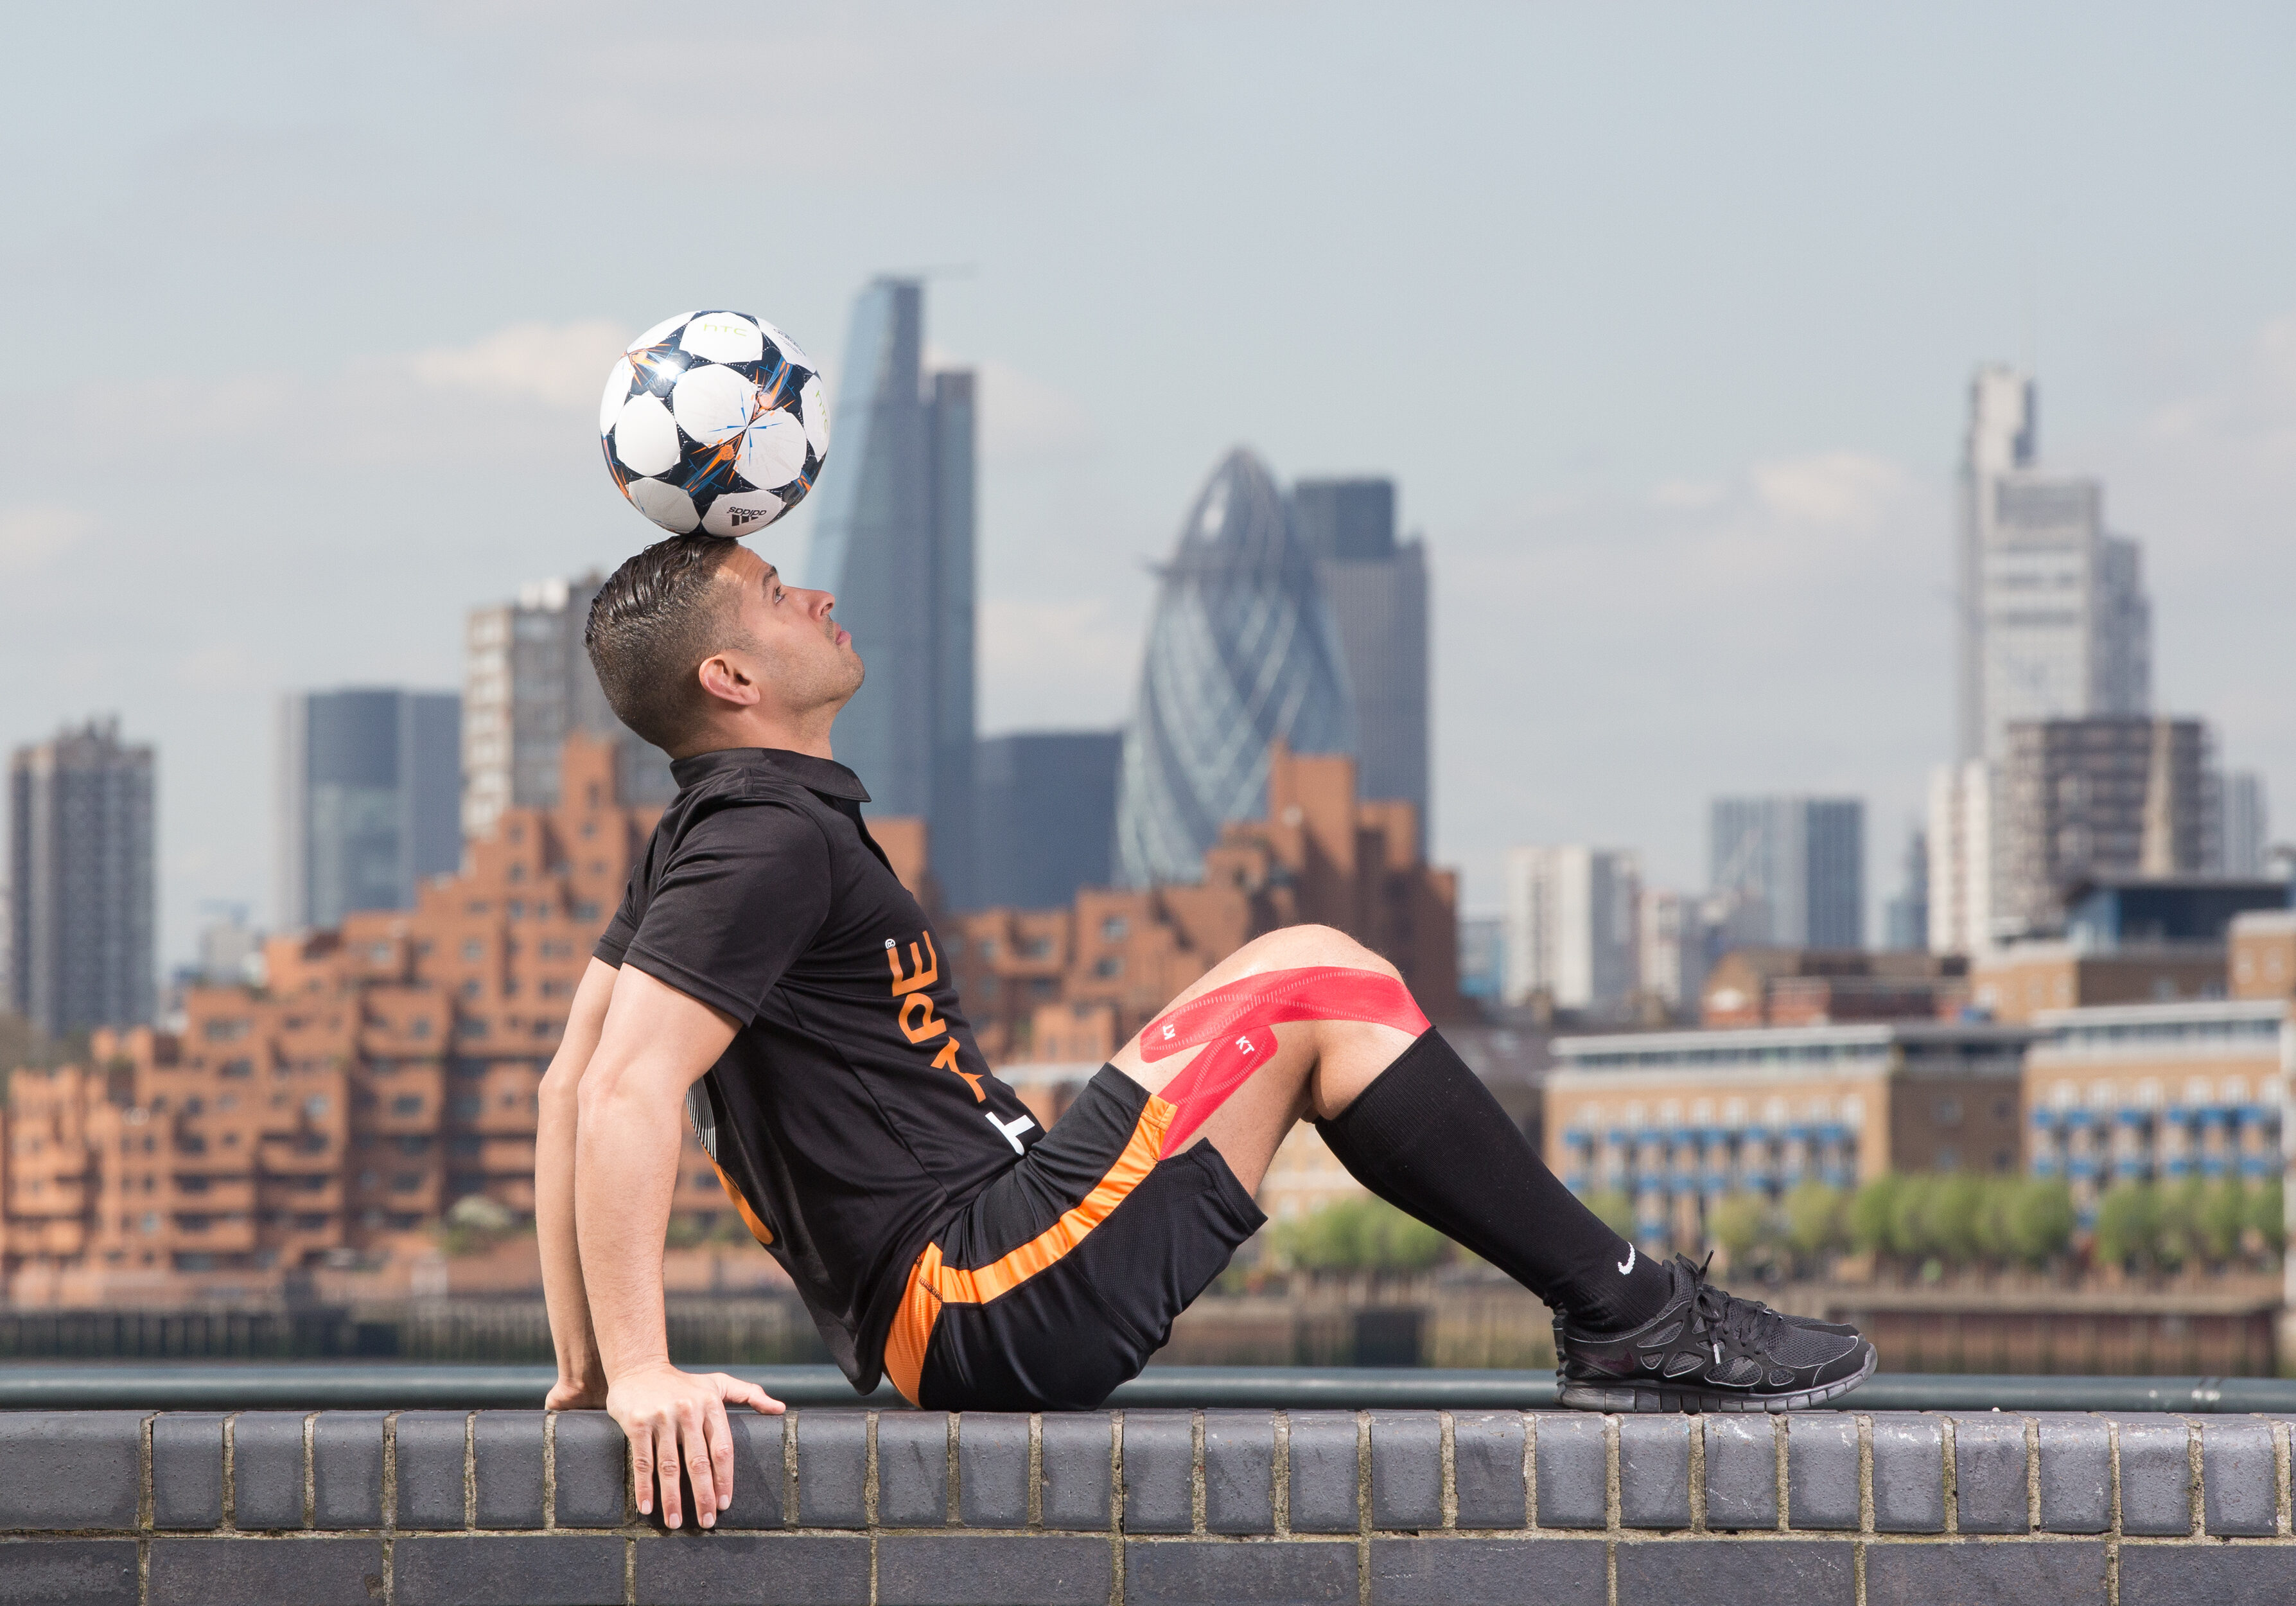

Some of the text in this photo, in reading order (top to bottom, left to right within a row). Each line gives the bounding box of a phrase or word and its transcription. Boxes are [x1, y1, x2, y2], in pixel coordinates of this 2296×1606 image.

[728, 506, 767, 517] adidas
[1162, 1024, 1176, 1041] KT
[1235, 1036, 1255, 1055] KT
